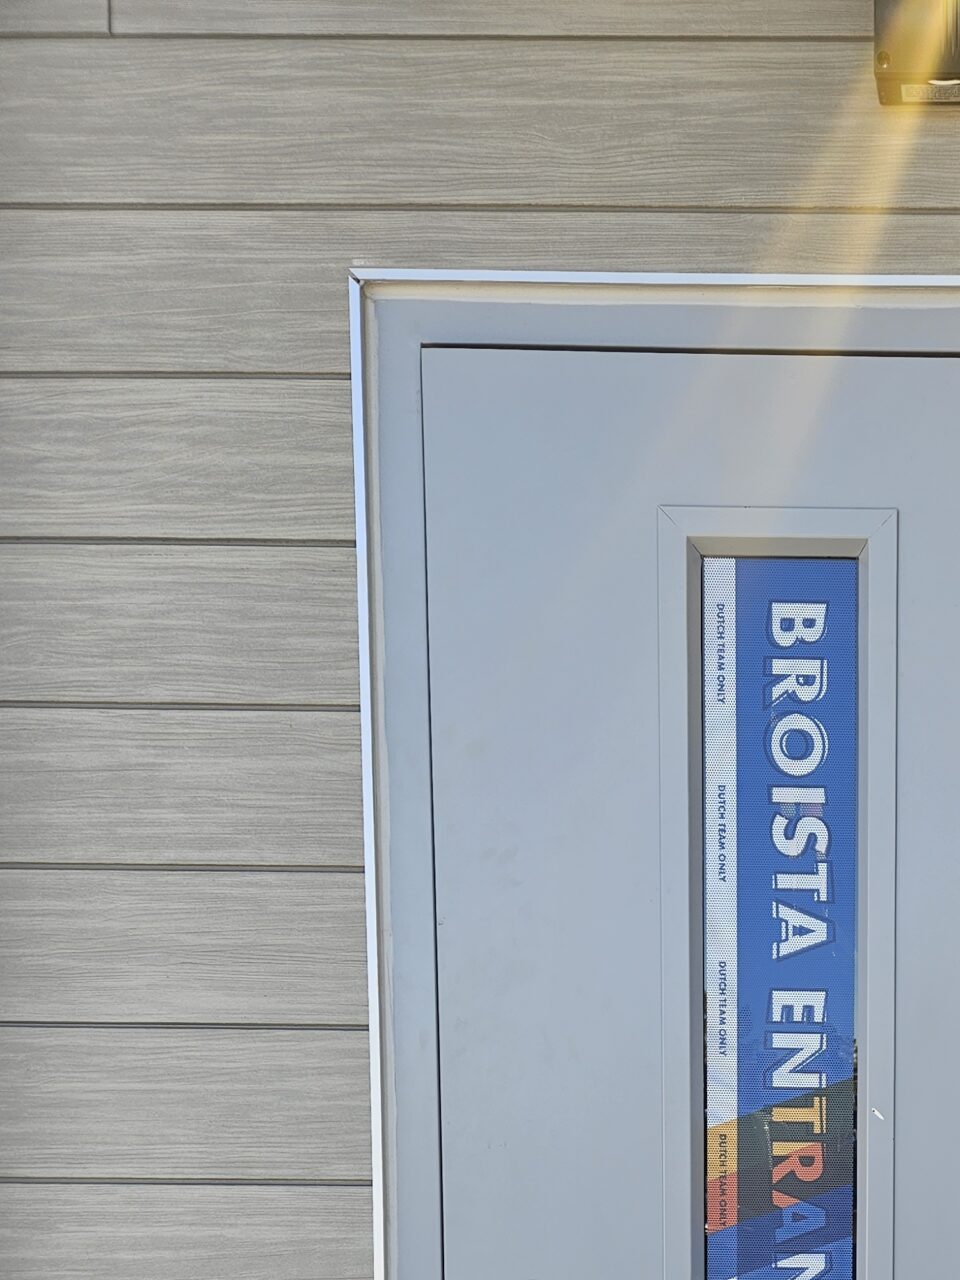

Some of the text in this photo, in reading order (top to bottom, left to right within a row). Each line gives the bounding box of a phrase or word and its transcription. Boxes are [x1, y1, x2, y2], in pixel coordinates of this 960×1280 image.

[717, 604, 725, 704] DUTCH TEAM ONLY
[765, 601, 834, 960] BROISTA
[718, 785, 726, 882] DUTCH TEAM ONLY
[719, 961, 727, 1056] DUTCH TEAM ONLY
[719, 1133, 727, 1226] DUTCH TEAM ONLY
